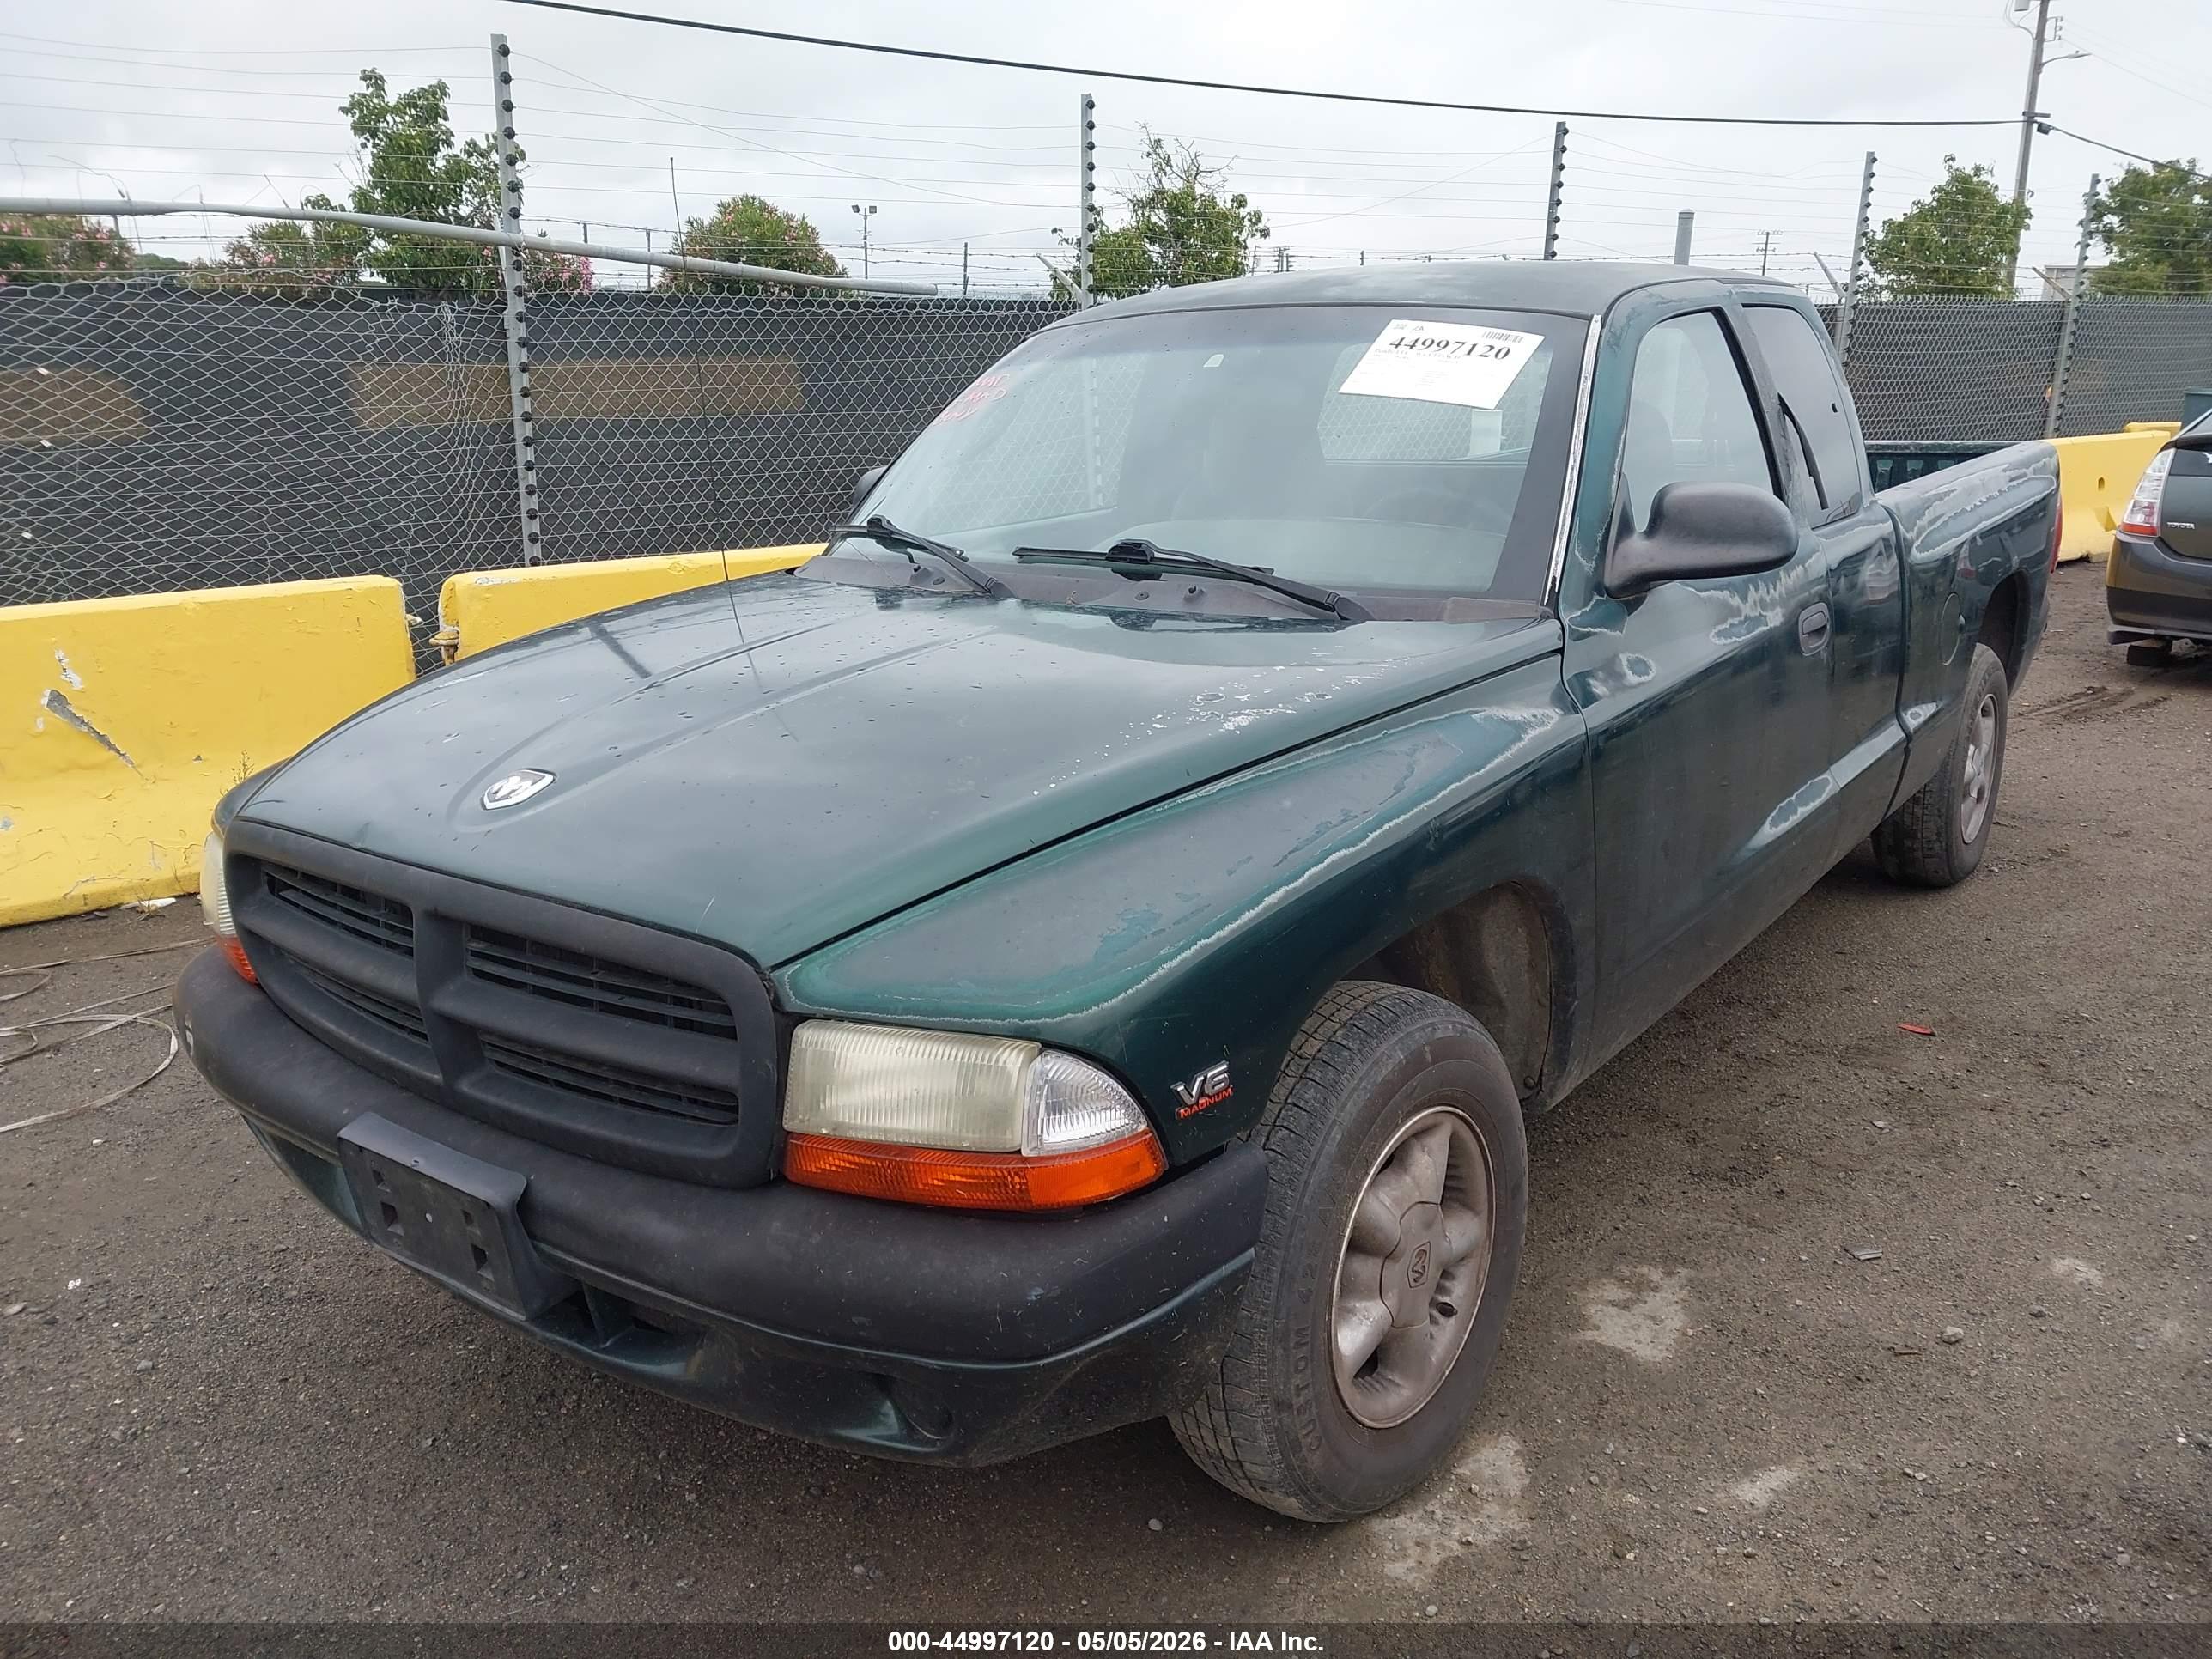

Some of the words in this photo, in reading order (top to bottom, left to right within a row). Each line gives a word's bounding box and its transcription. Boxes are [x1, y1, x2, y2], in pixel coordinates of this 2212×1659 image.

[1389, 337, 1510, 359] 44997120
[1170, 1060, 1230, 1105] V6
[1175, 1086, 1233, 1119] MAGNUM
[1292, 1325, 1322, 1451] CUSTOM
